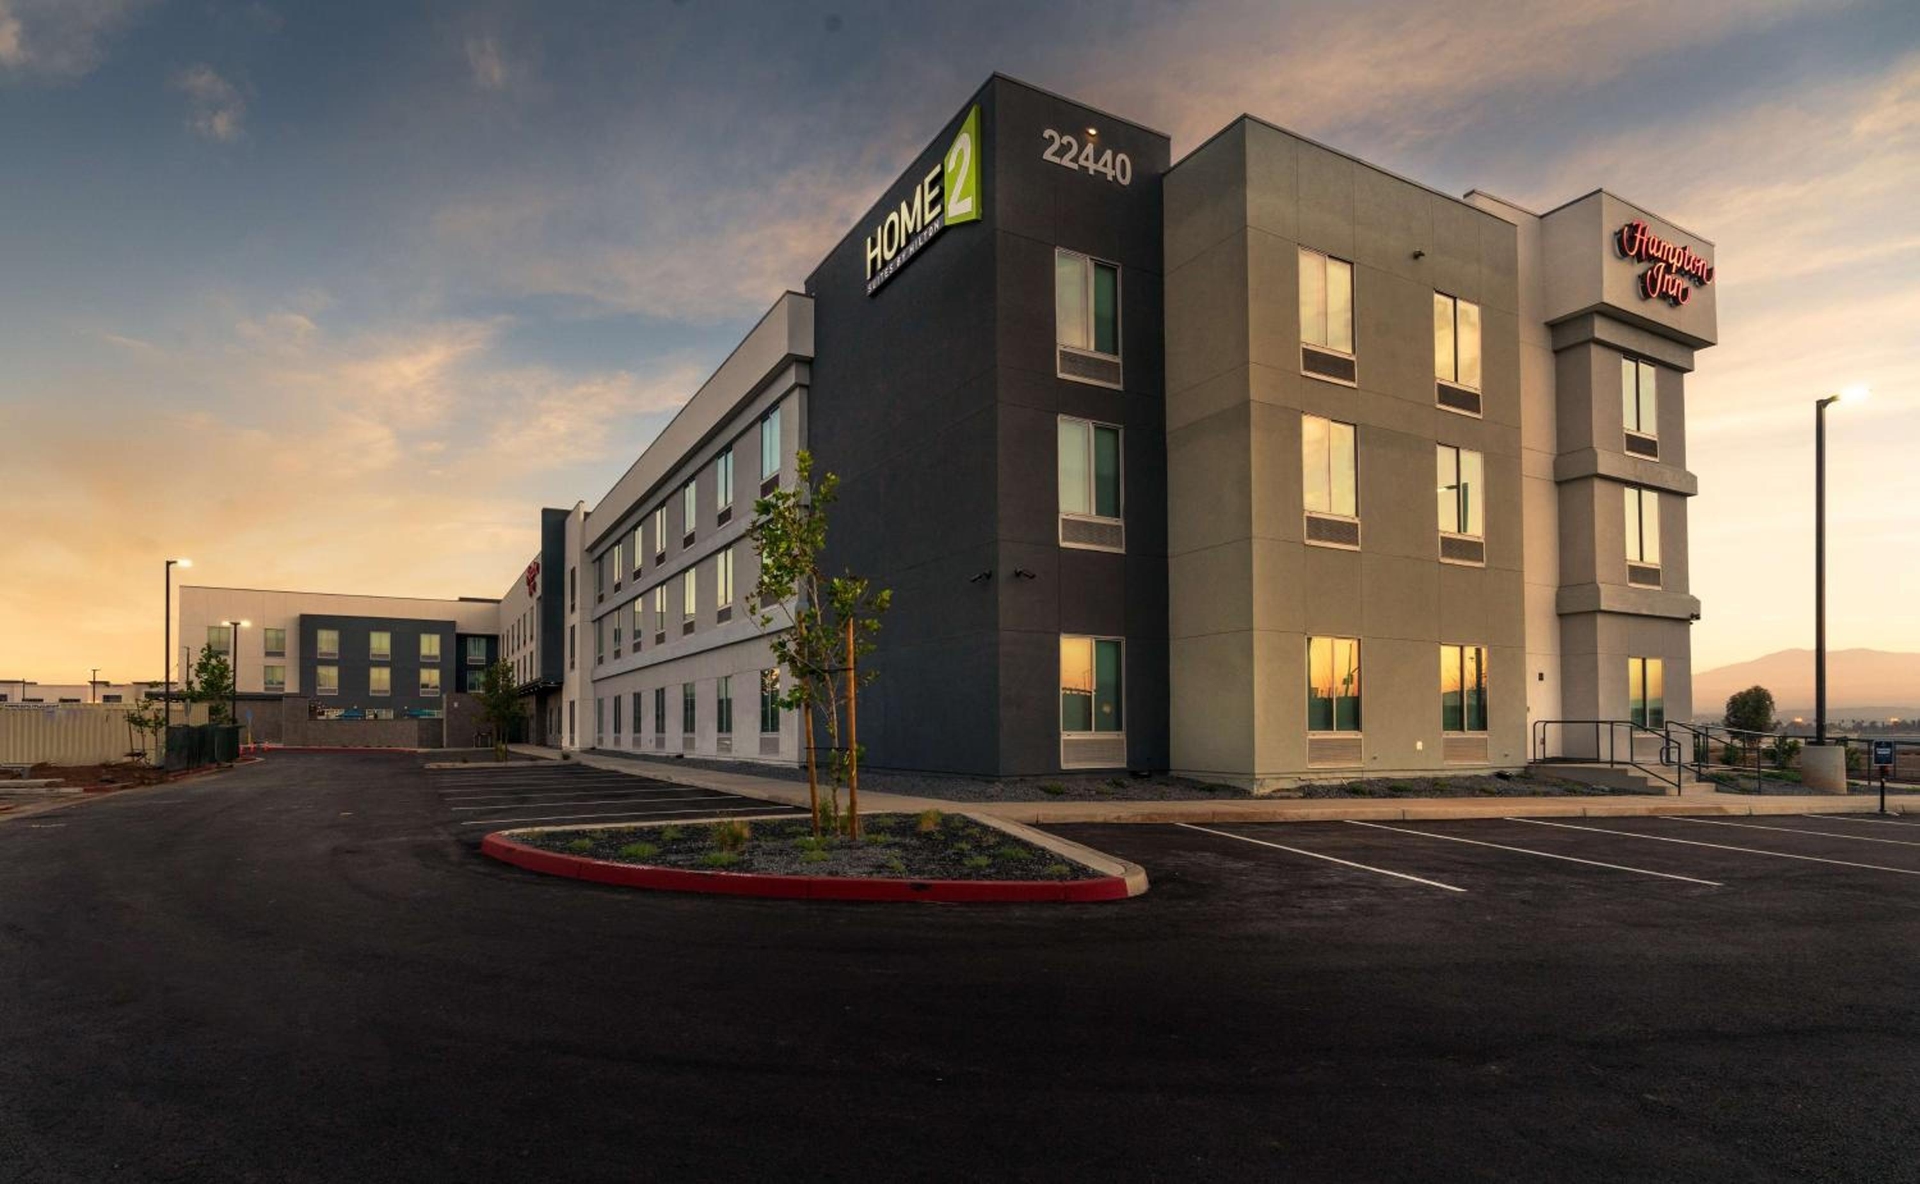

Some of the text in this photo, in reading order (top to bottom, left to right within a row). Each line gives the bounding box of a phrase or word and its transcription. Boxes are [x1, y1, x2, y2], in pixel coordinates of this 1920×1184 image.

[1042, 128, 1132, 186] 22440
[866, 132, 973, 281] HOME 2
[867, 263, 894, 293] SUITES
[909, 219, 940, 254] HILTON
[1616, 219, 1715, 286] Hampton
[1640, 262, 1691, 305] Inn
